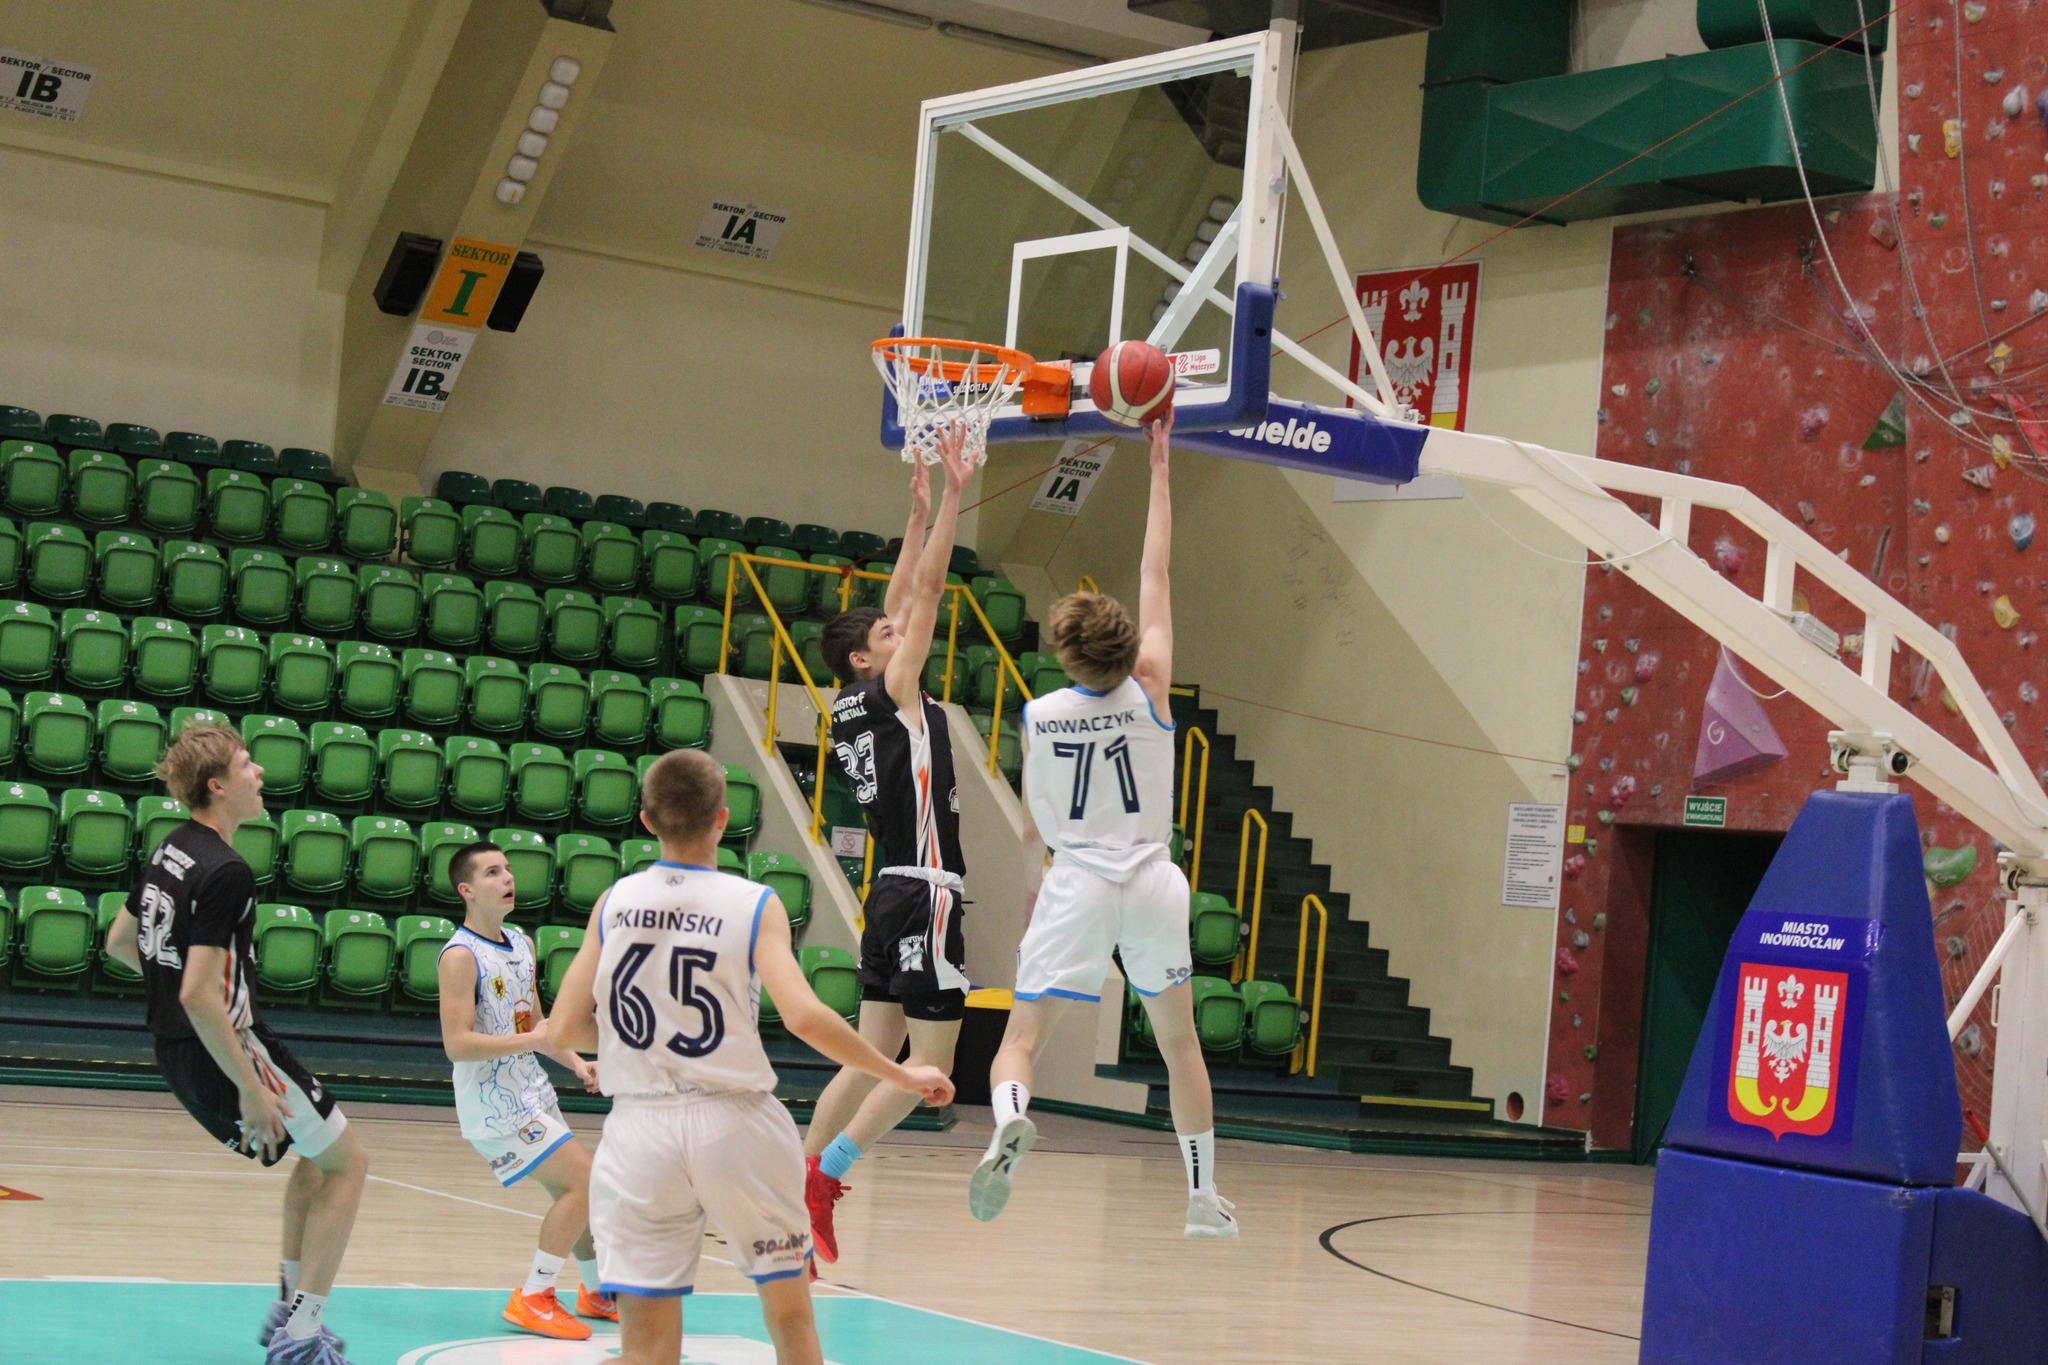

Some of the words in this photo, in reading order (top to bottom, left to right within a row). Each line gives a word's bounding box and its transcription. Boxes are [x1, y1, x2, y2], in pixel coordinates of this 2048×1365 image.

[0, 56, 41, 70] SEKTOR
[51, 66, 92, 81] SECTOR
[16, 70, 62, 102] IB
[712, 202, 746, 215] SEKTOR
[753, 211, 786, 224] SECTOR
[721, 215, 757, 244] IA
[451, 244, 511, 266] SEKTOR
[442, 269, 488, 316] I
[410, 346, 461, 362] SEKTOR
[412, 357, 452, 370] SECTOR
[401, 368, 445, 396] IB
[1058, 467, 1092, 478] SECTOR
[1059, 457, 1101, 471] SEKTOR
[1046, 476, 1080, 502] IA
[838, 705, 868, 722] METALL
[1035, 709, 1135, 736] NOWACZYK
[1052, 734, 1140, 820] 71
[1689, 801, 1722, 812] WYJŚCIE
[1781, 921, 1829, 936] MIASTO
[1759, 932, 1845, 951] INOWROCŁAW
[609, 943, 725, 1059] 65
